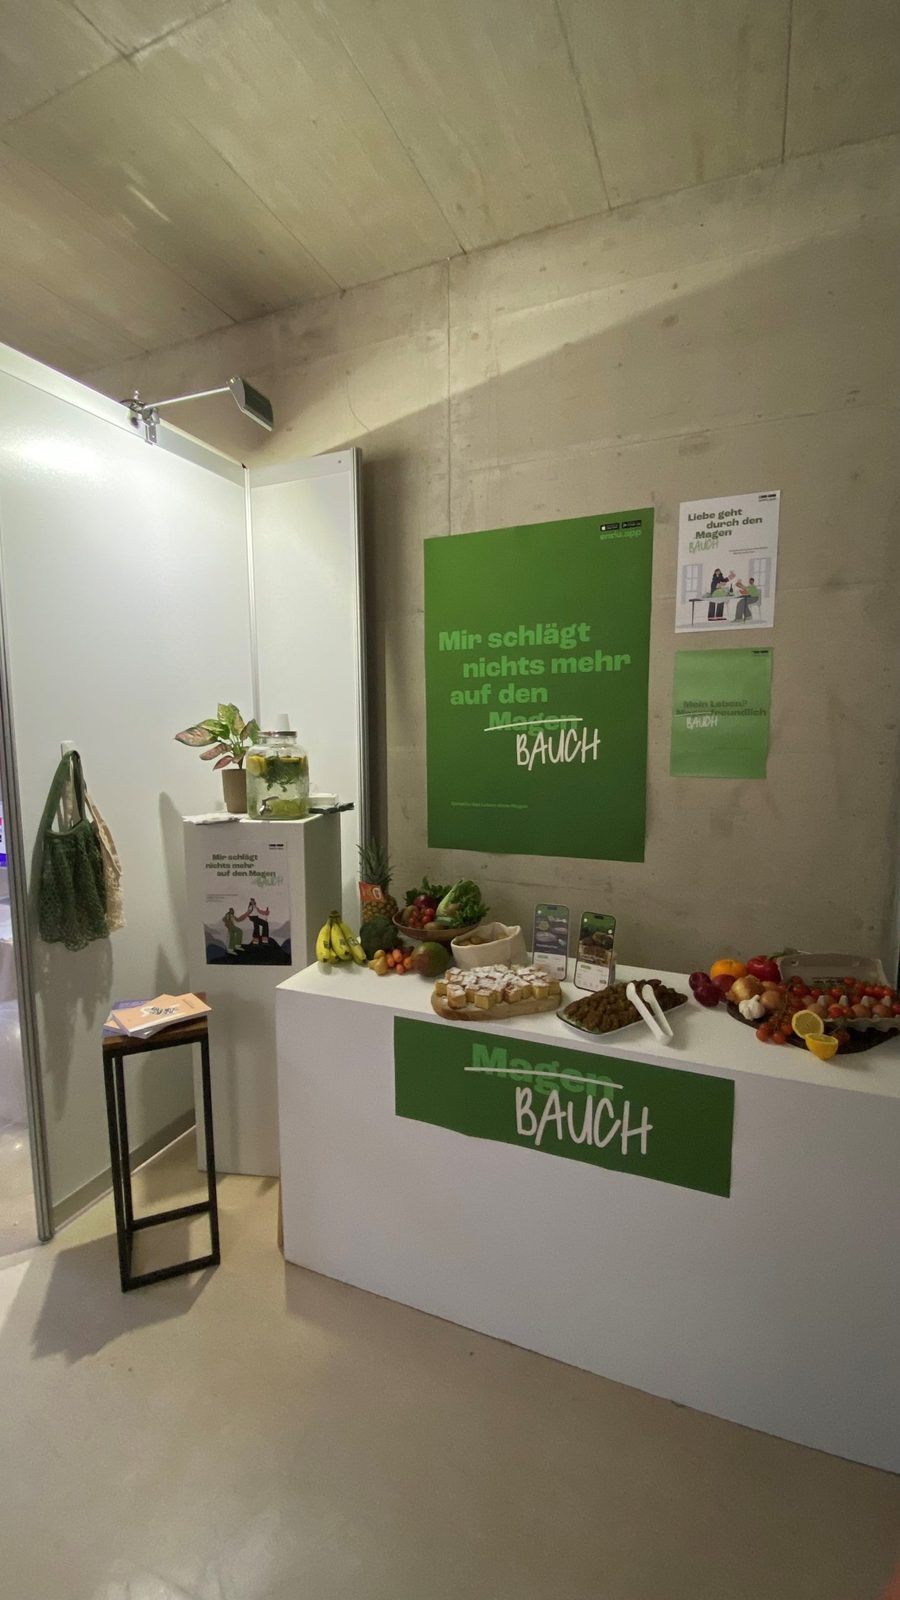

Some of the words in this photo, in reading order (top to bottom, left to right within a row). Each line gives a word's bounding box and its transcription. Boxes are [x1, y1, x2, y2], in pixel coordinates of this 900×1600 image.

[688, 512, 715, 521] Liebe
[718, 508, 742, 520] geht
[706, 518, 739, 529] durch
[742, 517, 762, 525] den
[695, 530, 732, 539] Magen
[438, 630, 482, 651] Mir
[487, 623, 591, 649] schlägt
[463, 656, 545, 678] nichts
[551, 650, 631, 673] mehr
[450, 683, 492, 705] auf
[498, 683, 548, 704] den
[488, 712, 578, 737] Magen
[516, 727, 601, 771] BAUCH
[228, 854, 258, 862] schlägt
[249, 870, 276, 879] Magen
[471, 1043, 615, 1101] Magen
[515, 1087, 653, 1155] BAUCH
